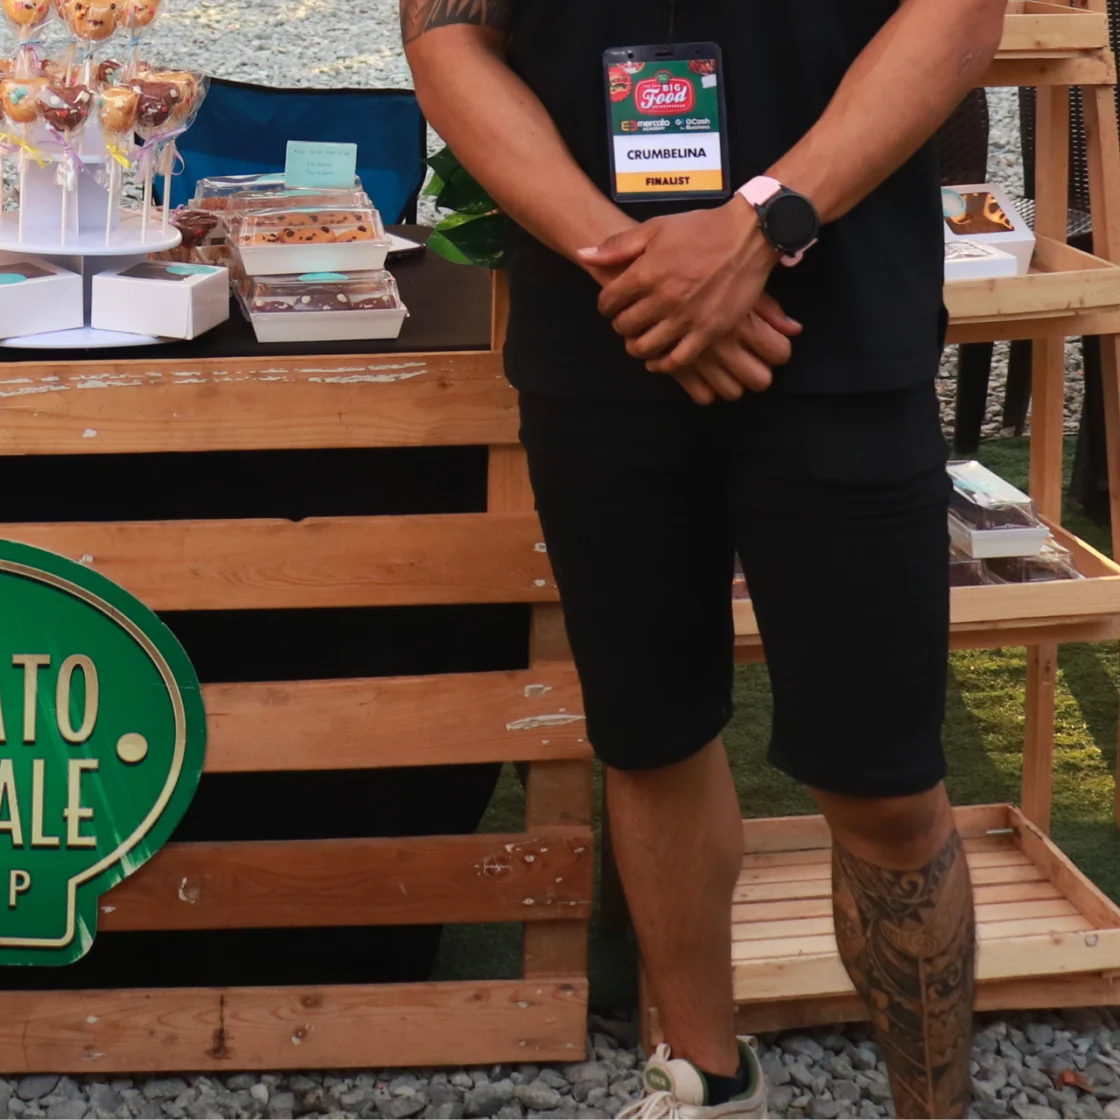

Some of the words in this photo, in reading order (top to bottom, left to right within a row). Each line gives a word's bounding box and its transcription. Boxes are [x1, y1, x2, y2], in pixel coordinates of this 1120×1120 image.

[662, 83, 681, 92] BIG
[640, 86, 688, 110] Food
[637, 118, 670, 128] mercato
[626, 147, 707, 161] CRUMBELINA
[645, 177, 690, 186] FINALIST
